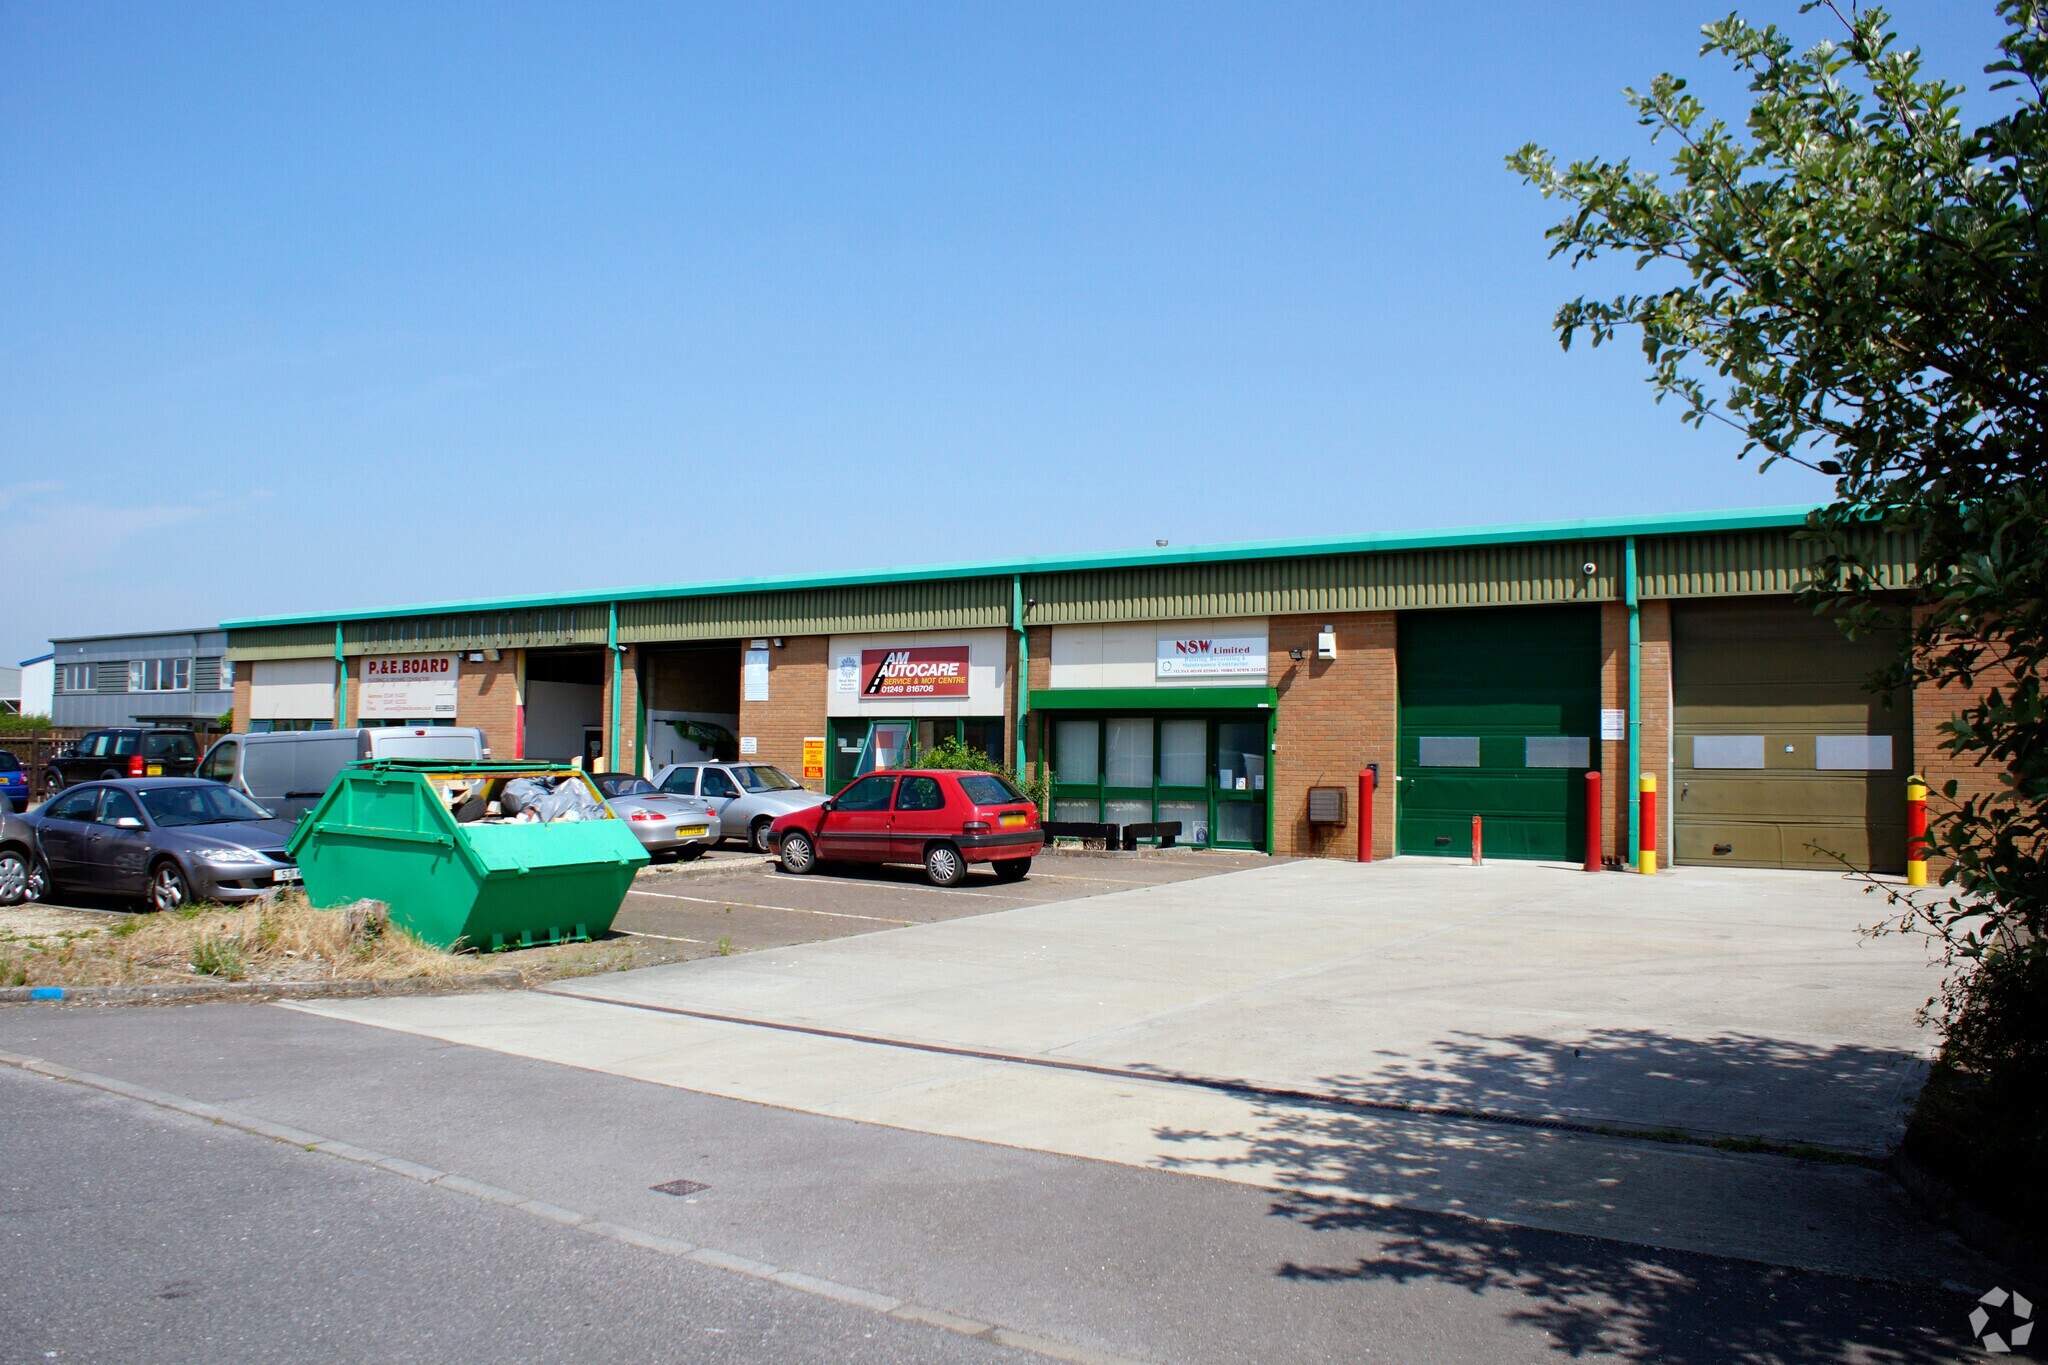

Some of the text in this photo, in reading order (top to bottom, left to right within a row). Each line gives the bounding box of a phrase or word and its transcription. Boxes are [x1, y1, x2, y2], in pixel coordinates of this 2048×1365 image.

[1175, 640, 1250, 655] NSW Limited
[884, 651, 910, 665] AM
[877, 662, 960, 678] AUTOCARE
[884, 676, 967, 686] SERVICE & MOT CENTRE
[881, 684, 934, 693] 01249 816706
